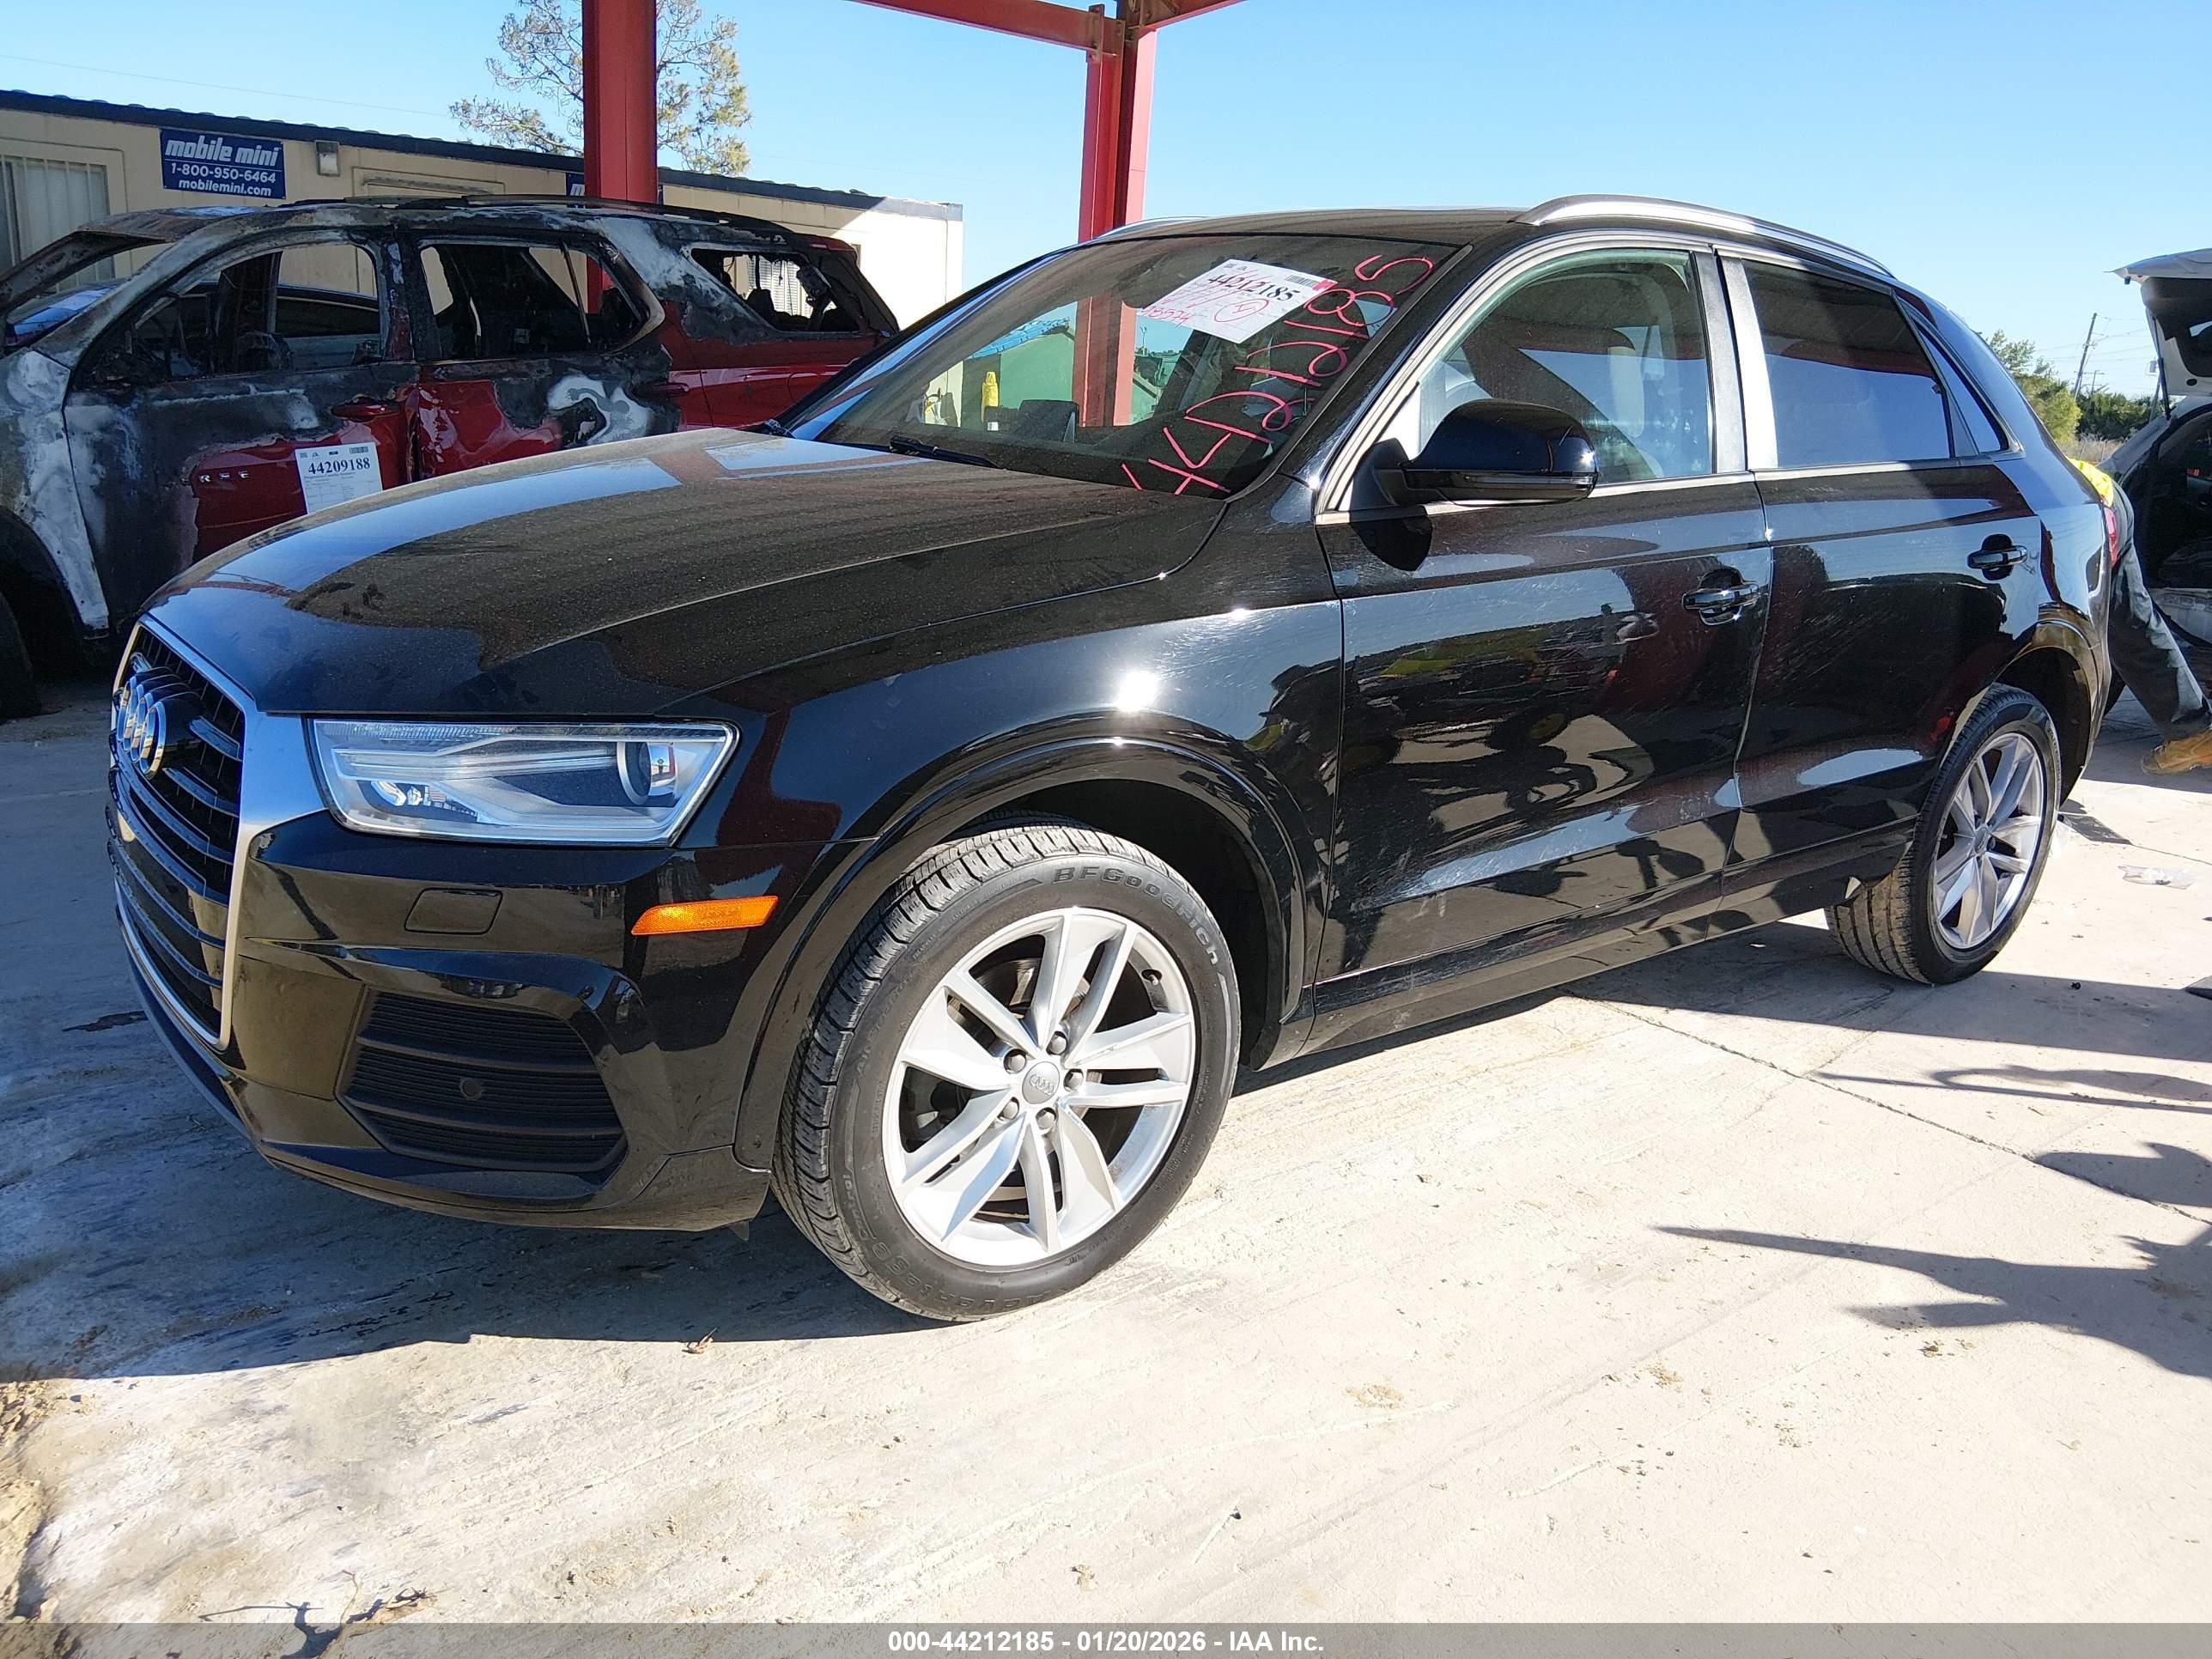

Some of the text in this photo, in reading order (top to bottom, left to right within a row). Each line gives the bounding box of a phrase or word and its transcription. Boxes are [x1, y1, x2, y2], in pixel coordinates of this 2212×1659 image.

[165, 136, 280, 167] mobile mini
[172, 162, 276, 184] 1-800-950-6464
[178, 179, 271, 197] mobilemini.com
[1208, 273, 1300, 301] 44212185
[308, 457, 371, 475] 44209188
